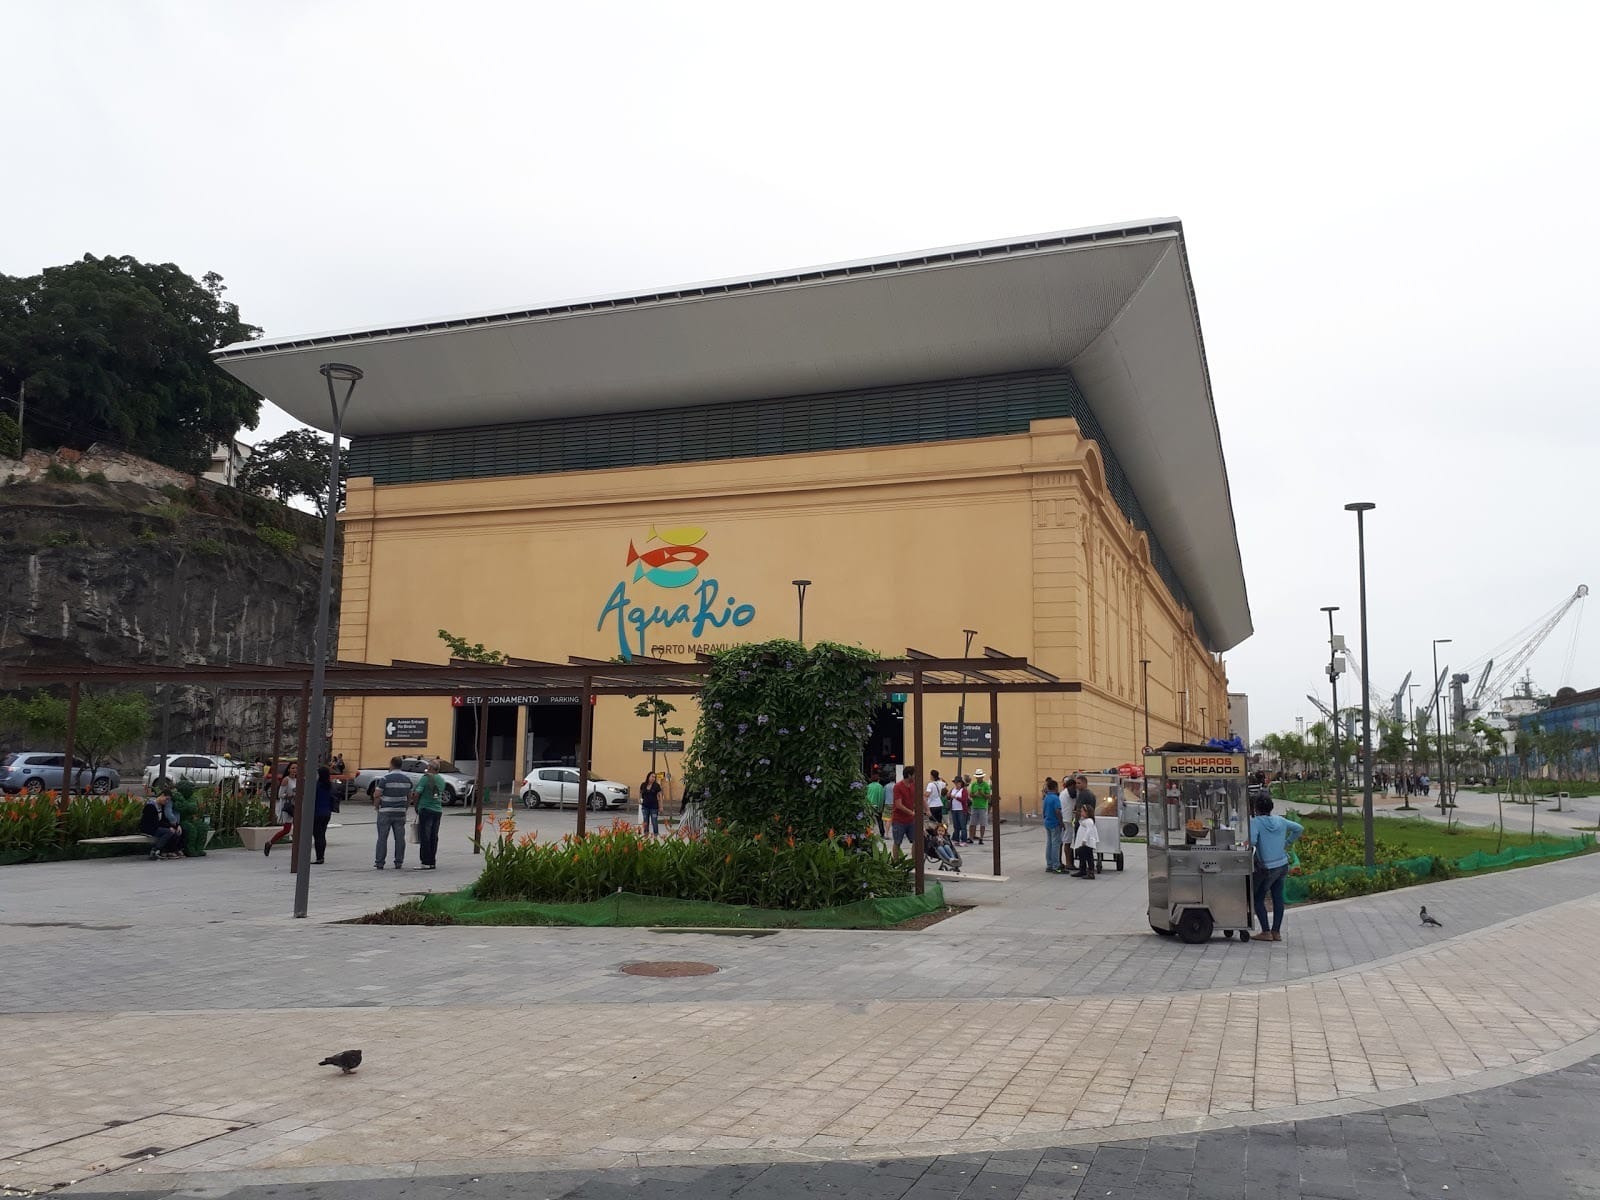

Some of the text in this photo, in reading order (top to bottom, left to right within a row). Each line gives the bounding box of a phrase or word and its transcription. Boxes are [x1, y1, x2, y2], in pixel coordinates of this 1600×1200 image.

[597, 579, 756, 661] AquaRio
[652, 641, 743, 655] PORTO MARAVIL
[1176, 757, 1232, 766] CHURROS
[1170, 766, 1240, 774] RECHEADOS
